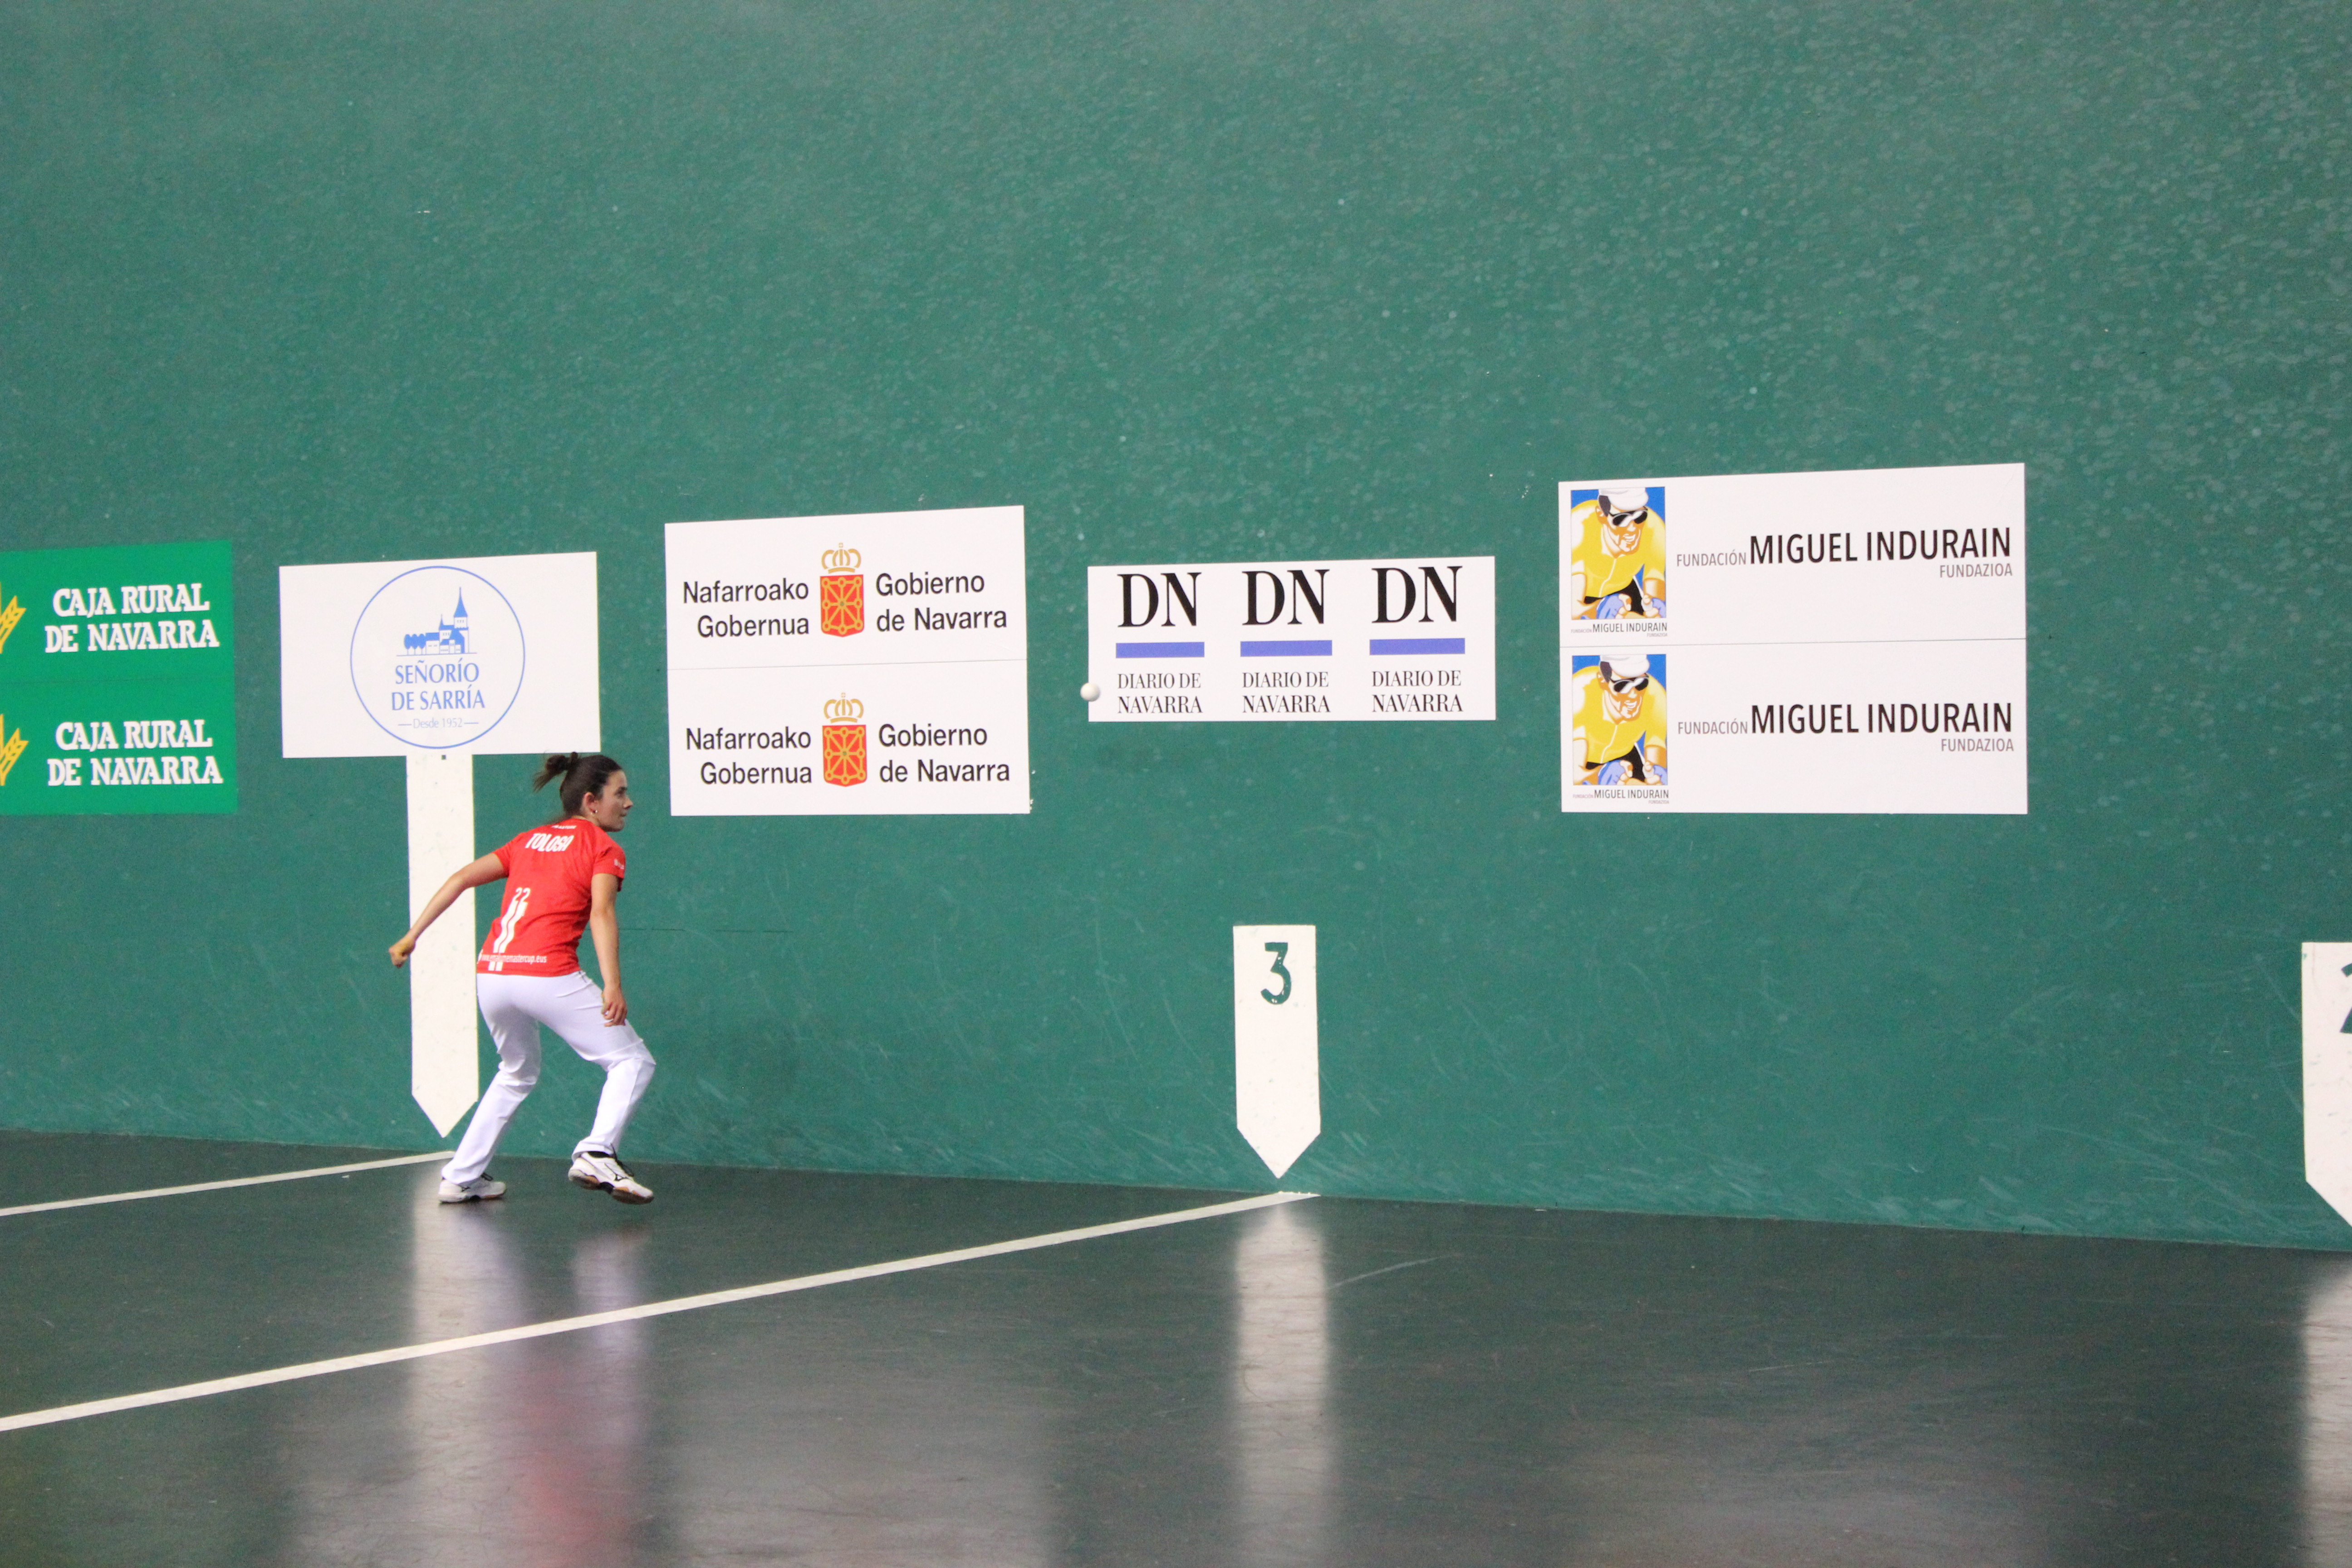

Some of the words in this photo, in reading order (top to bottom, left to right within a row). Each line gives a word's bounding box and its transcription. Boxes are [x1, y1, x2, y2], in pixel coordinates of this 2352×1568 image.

[1677, 550, 1746, 567] FUNDACIÓN
[1750, 533, 1857, 564] MIGUEL
[1867, 527, 2010, 561] INDURAIN
[1940, 563, 2013, 578] FUNDAZIOA
[683, 578, 808, 603] Nafarroako
[876, 572, 985, 596] Gobierno
[1372, 566, 1462, 623] DN
[53, 588, 117, 618] CAJA
[121, 583, 210, 613] RURAL
[1117, 572, 1201, 627] DN
[1242, 569, 1330, 625] DN
[697, 614, 809, 638] Gobernua
[877, 609, 905, 632] de
[915, 607, 1007, 630] Navarra
[1592, 623, 1624, 632] MIGUEL
[1627, 622, 1667, 632] INDURAIN
[44, 625, 79, 653] DE
[87, 619, 220, 652] NAVARRA
[395, 657, 479, 684] SEÑORÍO
[1118, 673, 1175, 688] DIARIO
[1180, 673, 1200, 688] DE
[1243, 672, 1302, 687] DIARIO
[1307, 672, 1328, 687] DE
[1373, 671, 1433, 686] DIARIO
[1438, 670, 1461, 686] DE
[392, 691, 414, 710] DE
[420, 684, 485, 710] SARRÍA
[1119, 696, 1202, 713] NAVARRA
[1244, 695, 1330, 712] NAVARRA
[1373, 694, 1462, 712] NAVARRA
[413, 717, 439, 729] Desde
[442, 717, 462, 728] 1952
[1678, 718, 1748, 735] FUNDACIÓN
[1752, 704, 1859, 734] MIGUEL
[1868, 703, 2011, 733] INDURAIN
[55, 721, 118, 752] CAJA
[123, 719, 213, 750] RURAL
[686, 726, 811, 750] Nafarroako
[878, 723, 987, 747] Gobierno
[1941, 738, 2014, 752] FUNDAZIOA
[47, 758, 82, 786] DE
[90, 755, 224, 786] NAVARRA
[701, 762, 812, 785] Gobernua
[879, 760, 908, 783] de
[918, 759, 1009, 782] Navarra
[1594, 789, 1625, 799] MIGUEL
[1628, 789, 1669, 799] INDURAIN
[525, 833, 574, 852] TOLOSA
[511, 887, 530, 903] 22
[1261, 942, 1292, 1004] 3
